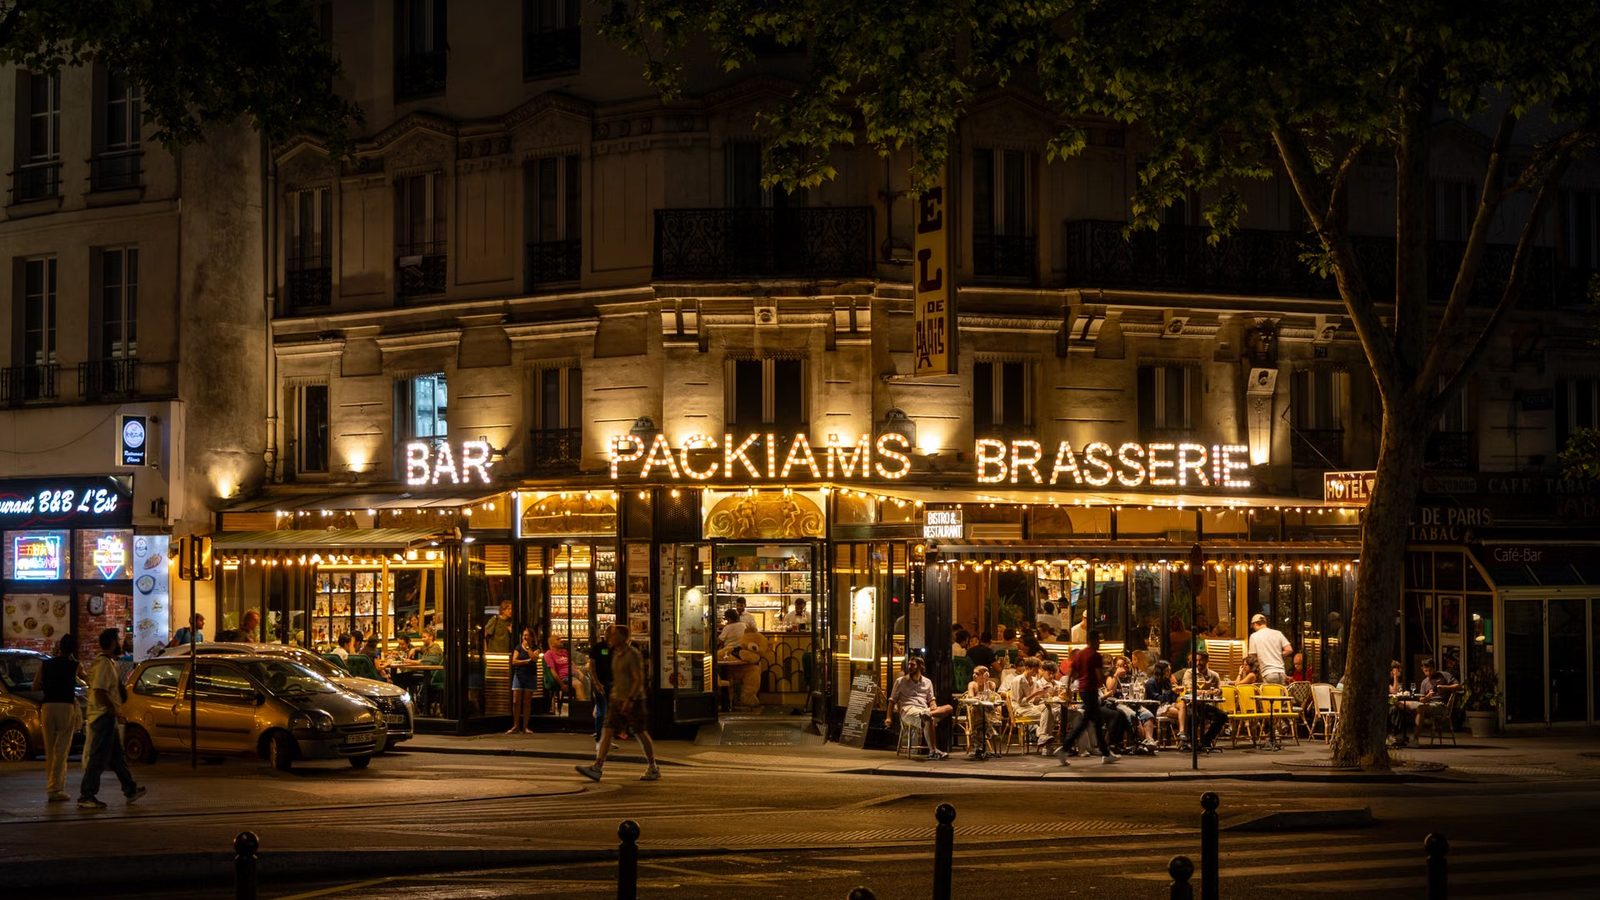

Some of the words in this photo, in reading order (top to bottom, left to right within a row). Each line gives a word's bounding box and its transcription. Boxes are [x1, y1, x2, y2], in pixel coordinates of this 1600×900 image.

[928, 300, 944, 314] DE
[406, 441, 491, 485] BAR
[608, 433, 912, 479] PACKIAMS
[975, 438, 1251, 487] BRASSERIE
[1326, 479, 1367, 499] HOTEL
[0, 496, 35, 514] urant
[38, 490, 75, 513] B&B
[76, 488, 118, 514] L'Est
[927, 511, 950, 525] BISTRO
[1422, 507, 1441, 525] DE
[1447, 507, 1490, 526] PARIS
[923, 524, 963, 539] RESTAURANT
[1410, 527, 1460, 541] TABAC
[1493, 547, 1543, 563] Café-Bar
